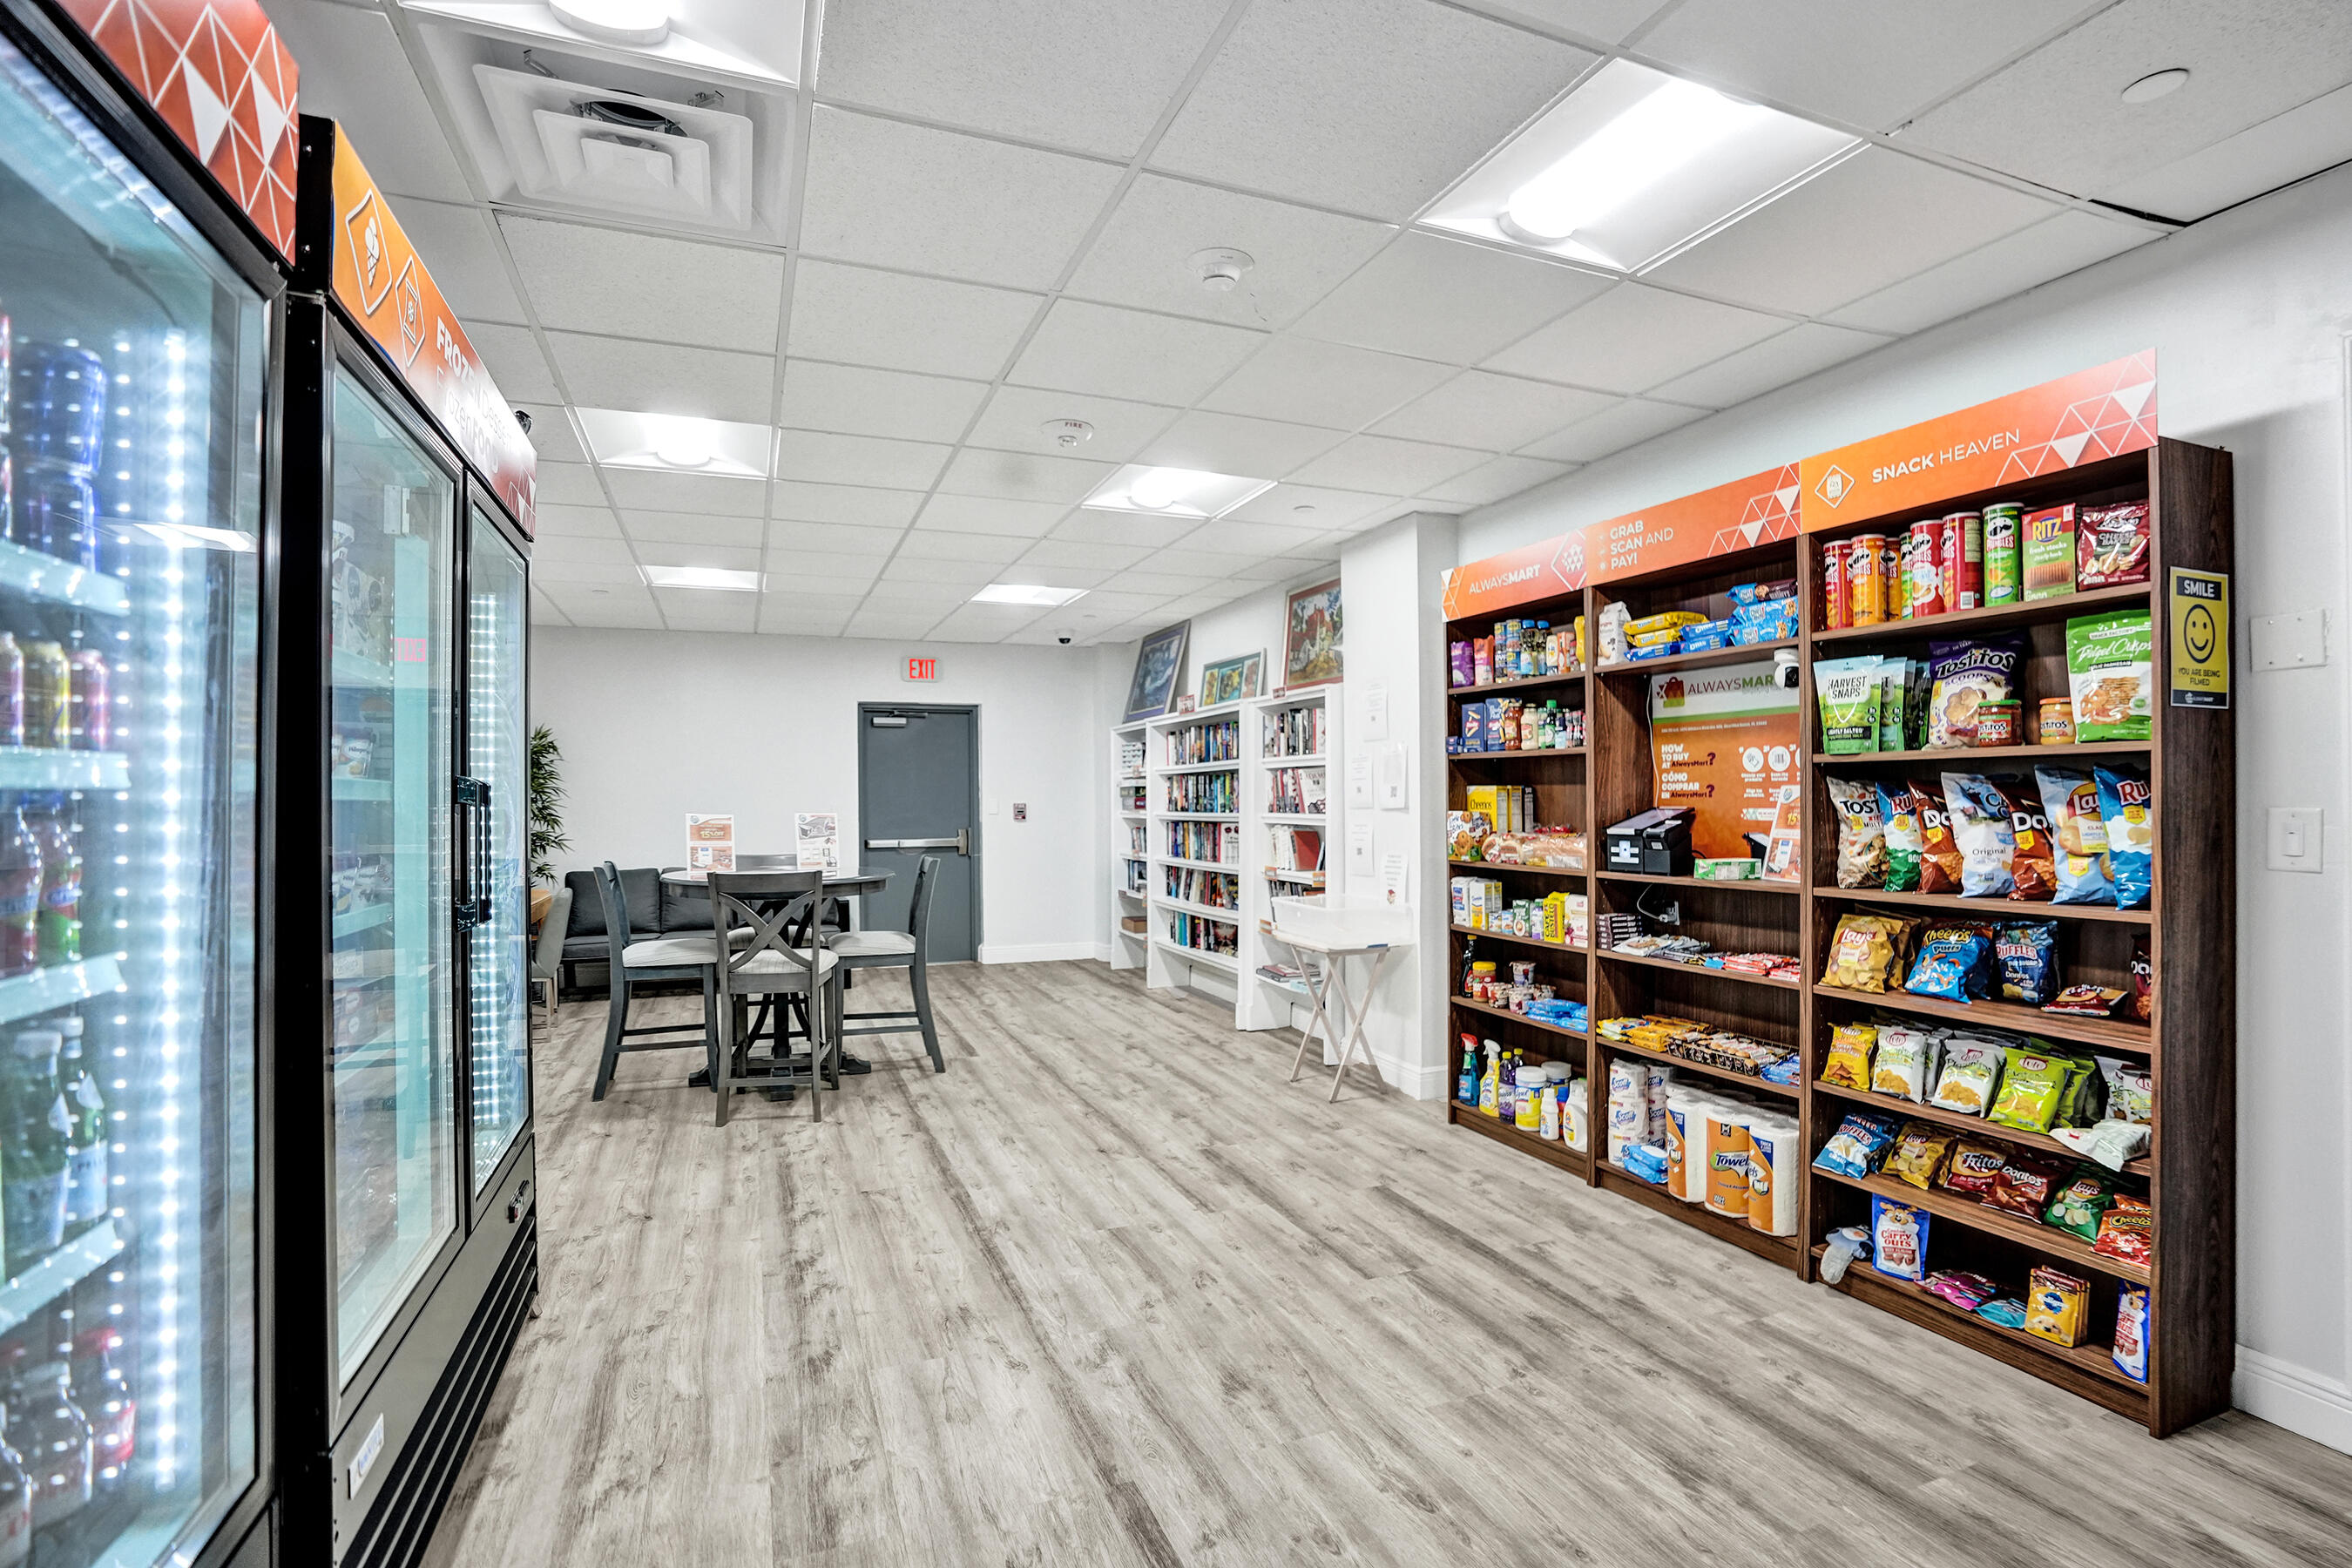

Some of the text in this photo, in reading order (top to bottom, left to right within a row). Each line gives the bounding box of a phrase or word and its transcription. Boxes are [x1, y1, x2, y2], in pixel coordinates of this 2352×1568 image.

[1872, 429, 2020, 483] SNACK HEAVEN
[1610, 520, 1644, 540] GRAB
[2032, 517, 2062, 541] RITZ
[1610, 527, 1674, 555] SCAN AND
[1611, 552, 1639, 571] PAY!
[1469, 563, 1541, 595] ALWAYSMART
[2184, 580, 2215, 598] SMILE
[909, 659, 936, 679] EXIT
[2178, 667, 2220, 678] YOU ARE BEING
[1828, 675, 1867, 691] HARVEST
[2189, 677, 2210, 686] FILMED
[1832, 687, 1861, 700] SNAPS
[1661, 743, 1684, 754] HOW
[1673, 752, 1689, 761] BUY
[1661, 771, 1688, 782] CÓMO
[1661, 781, 1700, 791] COMPRAR
[1788, 812, 1797, 826] 15
[1972, 848, 2006, 856] Original
[1842, 928, 1874, 944] Lay's
[1996, 944, 2038, 960] RUFFLES
[1616, 1111, 1636, 1122] Scott
[1963, 1152, 2003, 1169] Fritos
[2002, 1166, 2043, 1186] Doritos
[2072, 1180, 2100, 1196] Lay's
[1882, 1230, 1912, 1240] Carry
